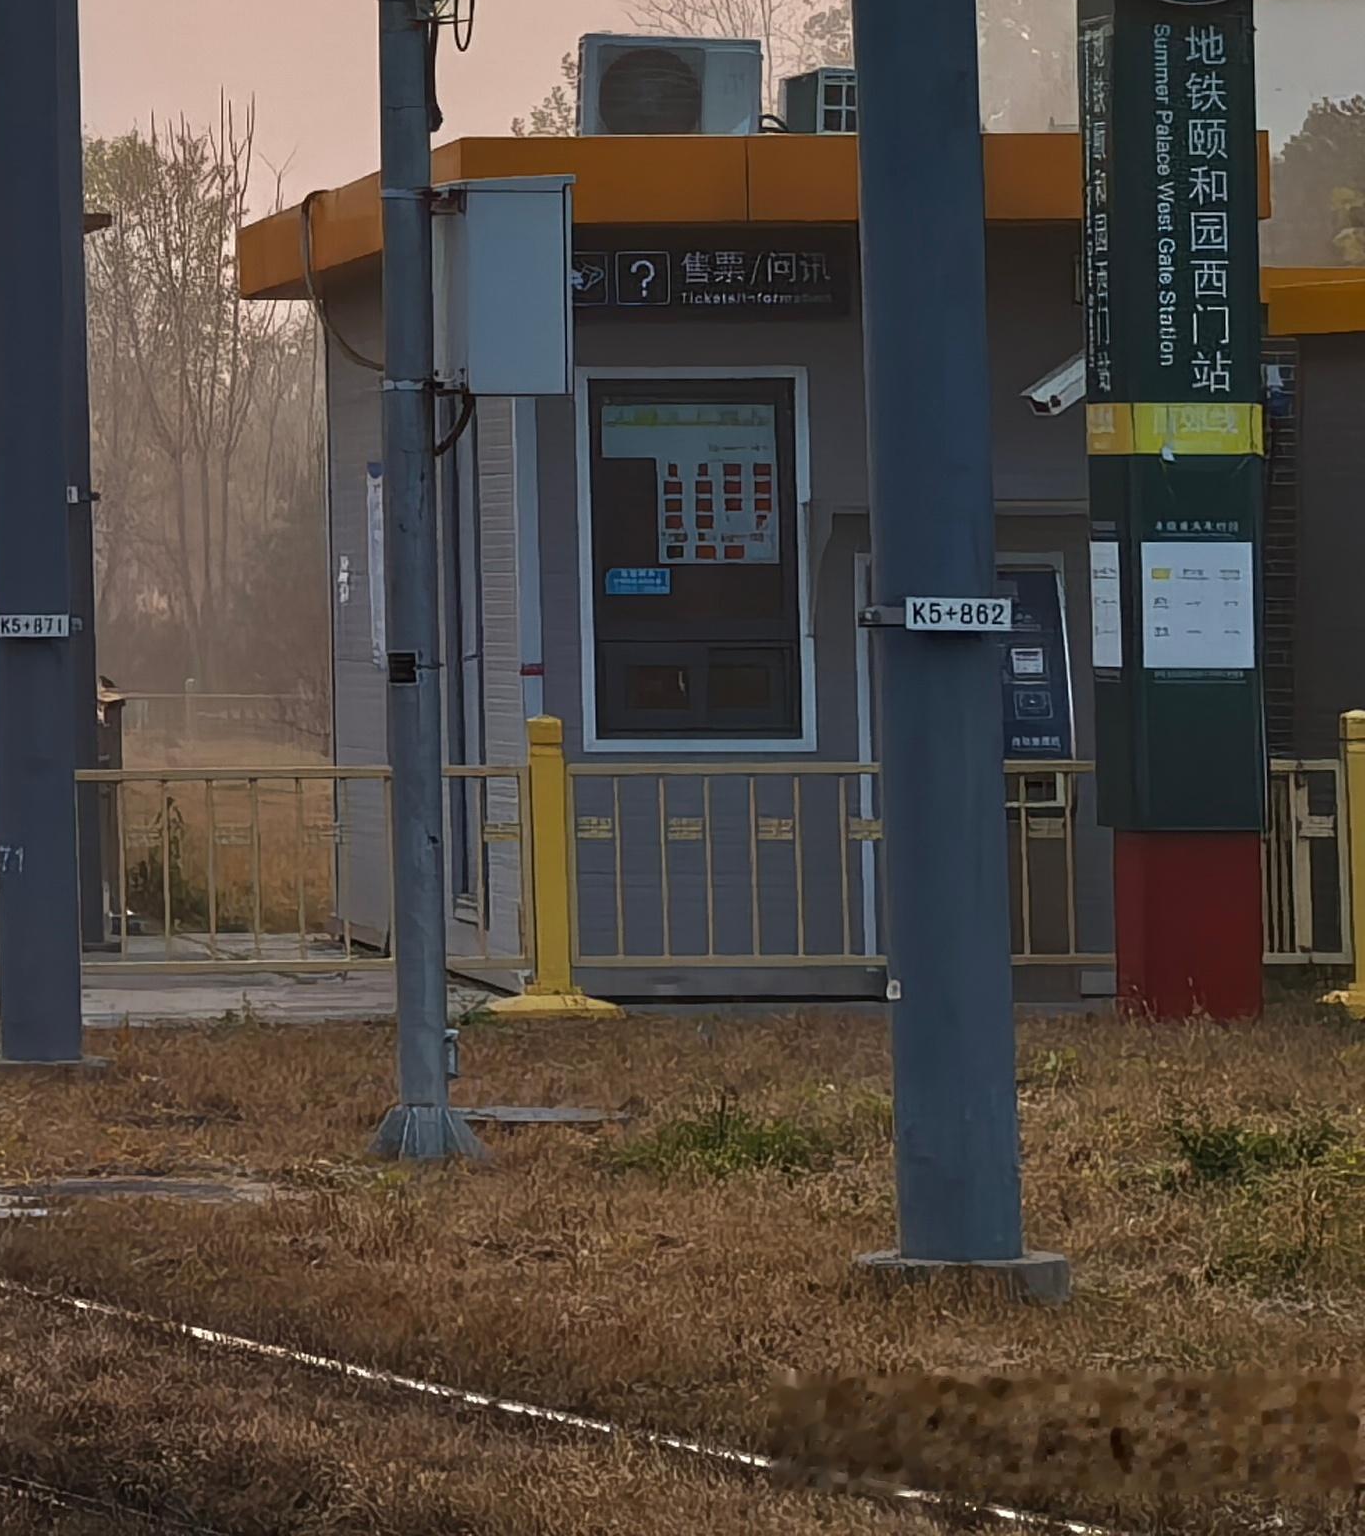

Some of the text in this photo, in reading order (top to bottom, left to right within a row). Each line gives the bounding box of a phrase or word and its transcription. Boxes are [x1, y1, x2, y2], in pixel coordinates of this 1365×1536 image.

[1153, 23, 1177, 367] Summer Palace West Gate Station
[1184, 24, 1233, 393] 地铁颐和园西门站
[681, 251, 831, 286] 售票/问讯
[1, 617, 62, 635] K5+871
[912, 602, 1006, 625] K5+862
